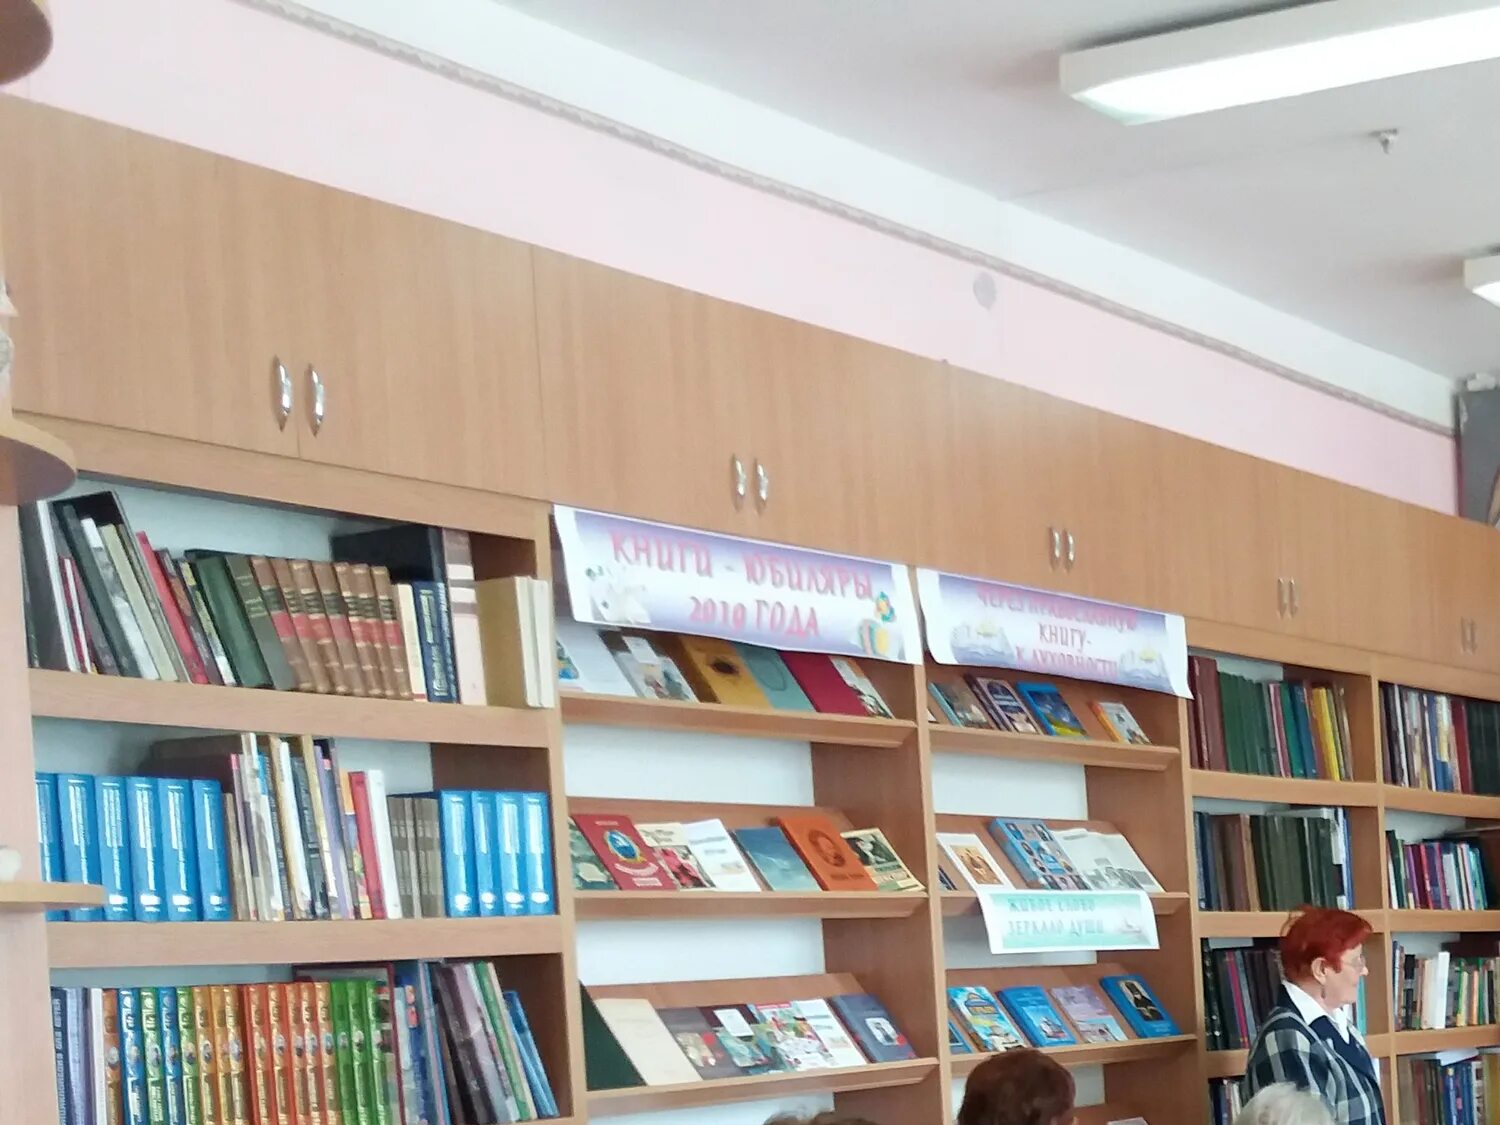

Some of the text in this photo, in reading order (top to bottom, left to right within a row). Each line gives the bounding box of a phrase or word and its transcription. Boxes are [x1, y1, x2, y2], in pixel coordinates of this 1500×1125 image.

[608, 529, 713, 577] КНИГИ
[742, 551, 874, 600] ЮБИЛЯРЫ
[755, 599, 820, 638] ГОДА
[1070, 919, 1105, 937] ДУШИ
